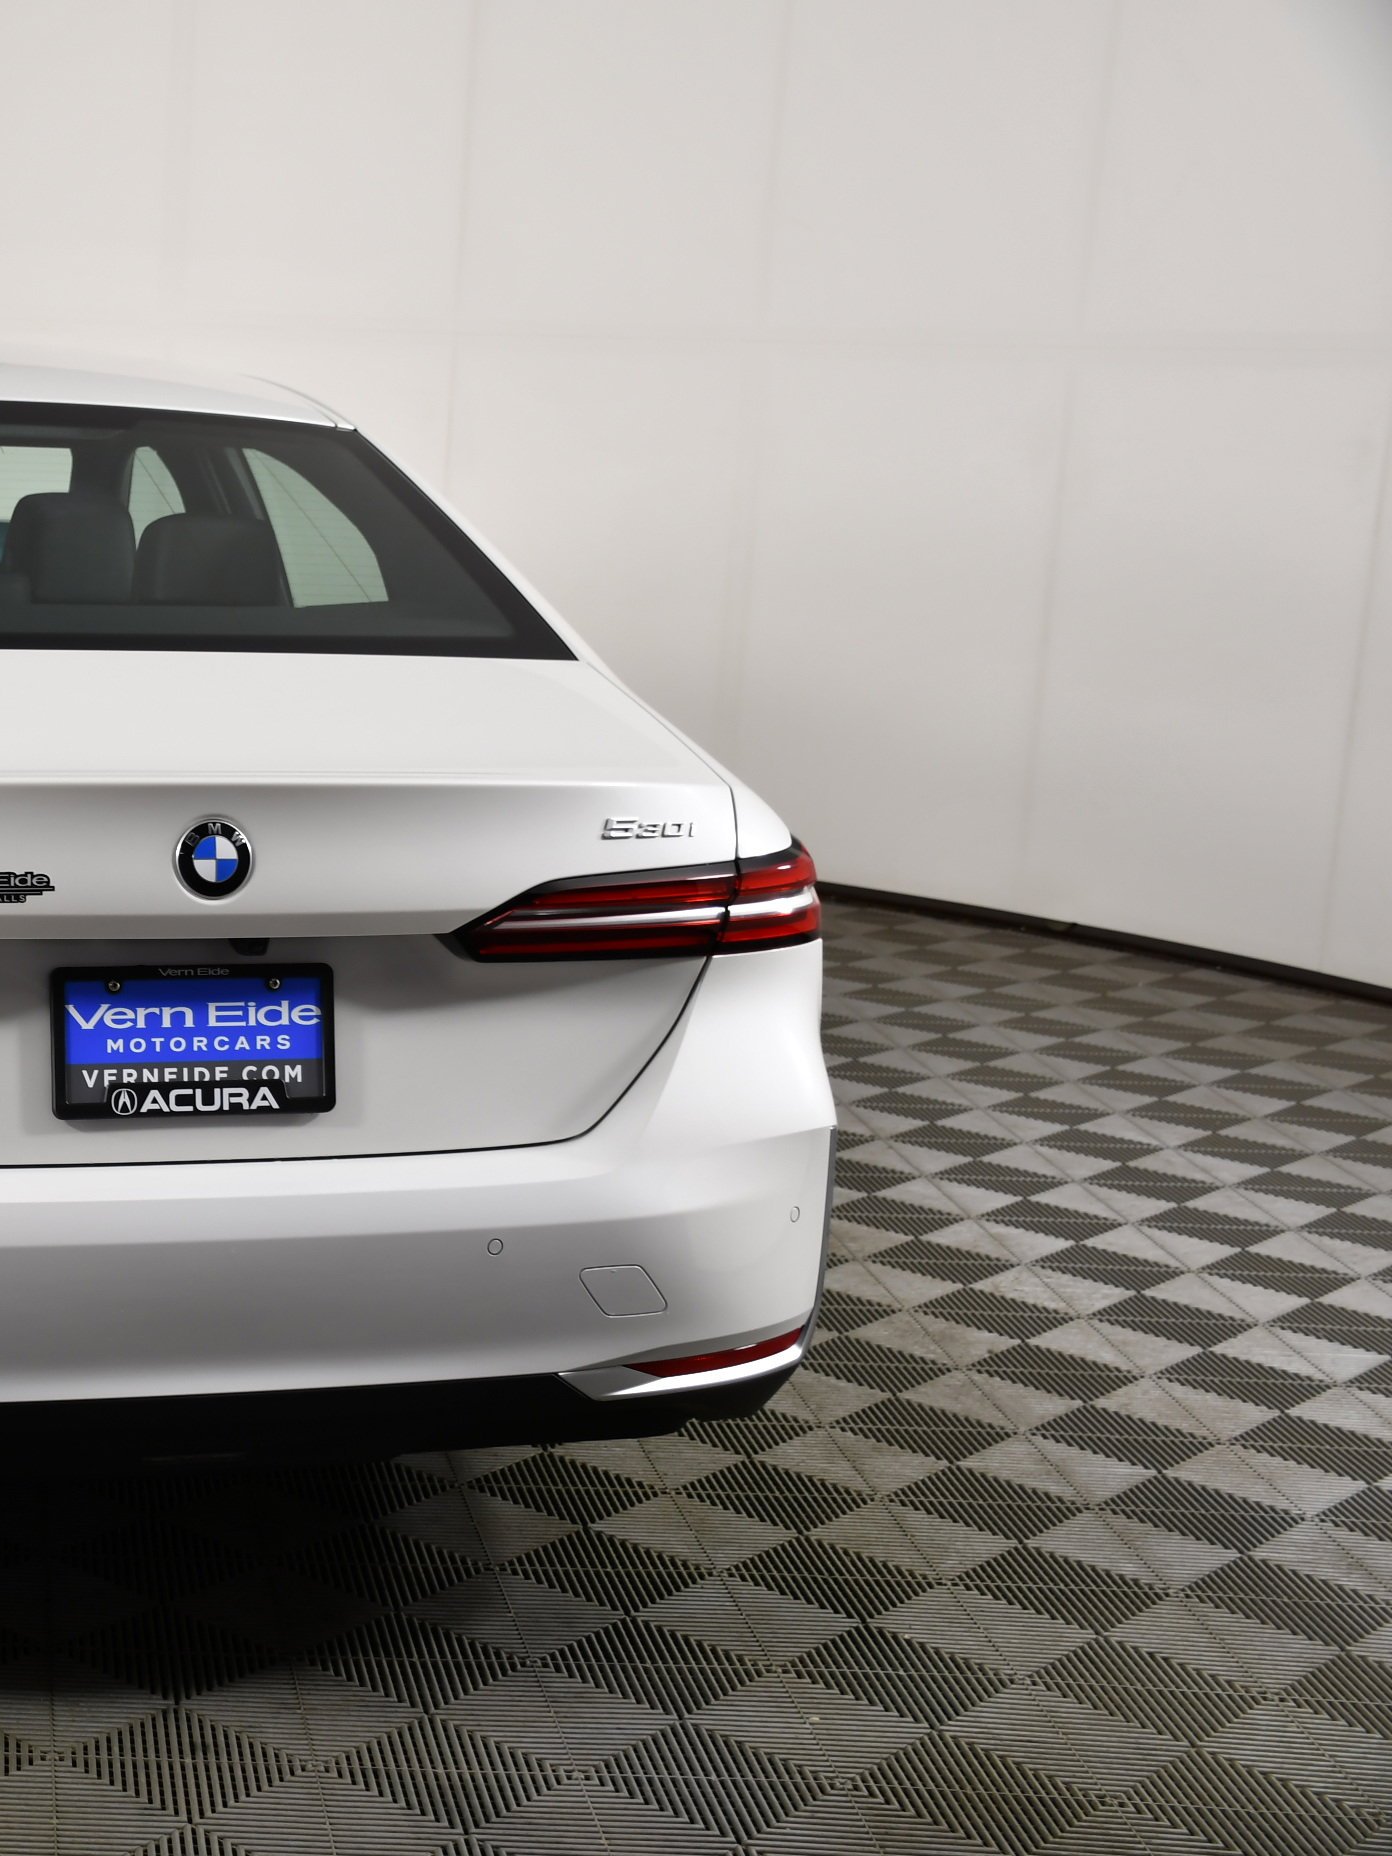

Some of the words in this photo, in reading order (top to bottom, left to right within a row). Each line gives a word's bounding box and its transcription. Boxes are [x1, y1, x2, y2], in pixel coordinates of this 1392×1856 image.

[185, 823, 246, 847] BMW
[601, 817, 694, 840] 530i
[158, 968, 194, 976] Vern
[197, 967, 230, 976] Eide
[64, 1003, 194, 1030] Vern
[206, 1000, 322, 1027] Eide
[106, 1035, 291, 1053] MOTORCARS
[81, 1064, 303, 1088] VERNEIDECOM
[139, 1086, 280, 1113] ACURA
